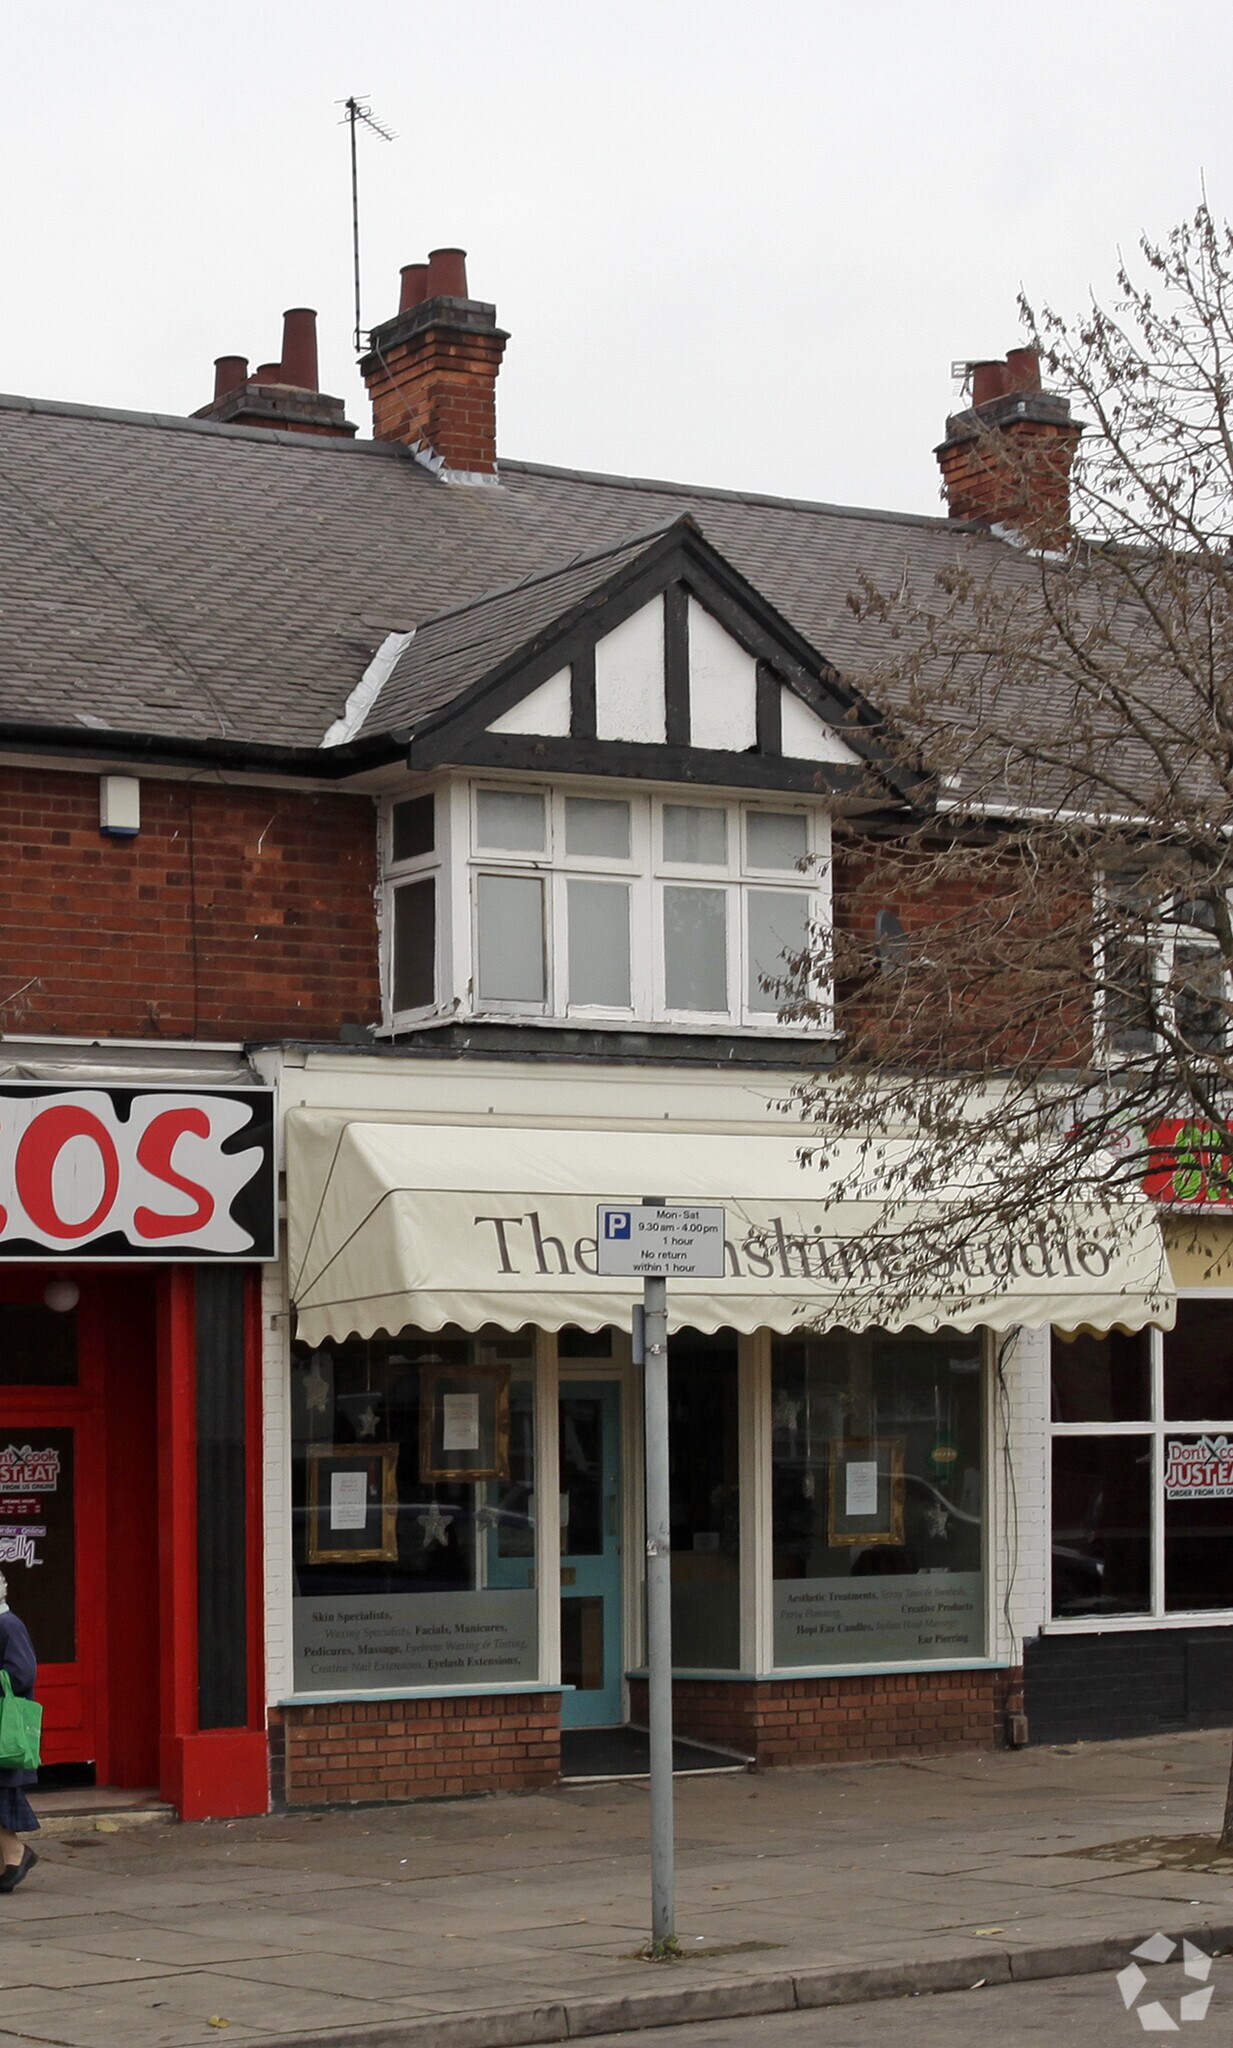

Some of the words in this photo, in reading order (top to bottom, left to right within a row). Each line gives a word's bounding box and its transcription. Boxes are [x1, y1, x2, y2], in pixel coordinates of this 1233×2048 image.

[0, 1104, 215, 1239] OS
[608, 1213, 627, 1238] P
[474, 1211, 598, 1276] The
[724, 1217, 912, 1278] nshine
[671, 1237, 694, 1246] hour
[641, 1250, 655, 1259] No
[657, 1250, 687, 1260] return
[633, 1263, 662, 1272] within
[672, 1263, 696, 1272] hour
[1194, 1488, 1214, 1497] FROM
[1216, 1488, 1225, 1496] US
[311, 1612, 335, 1622] Skin
[427, 1658, 464, 1670] Eyelash
